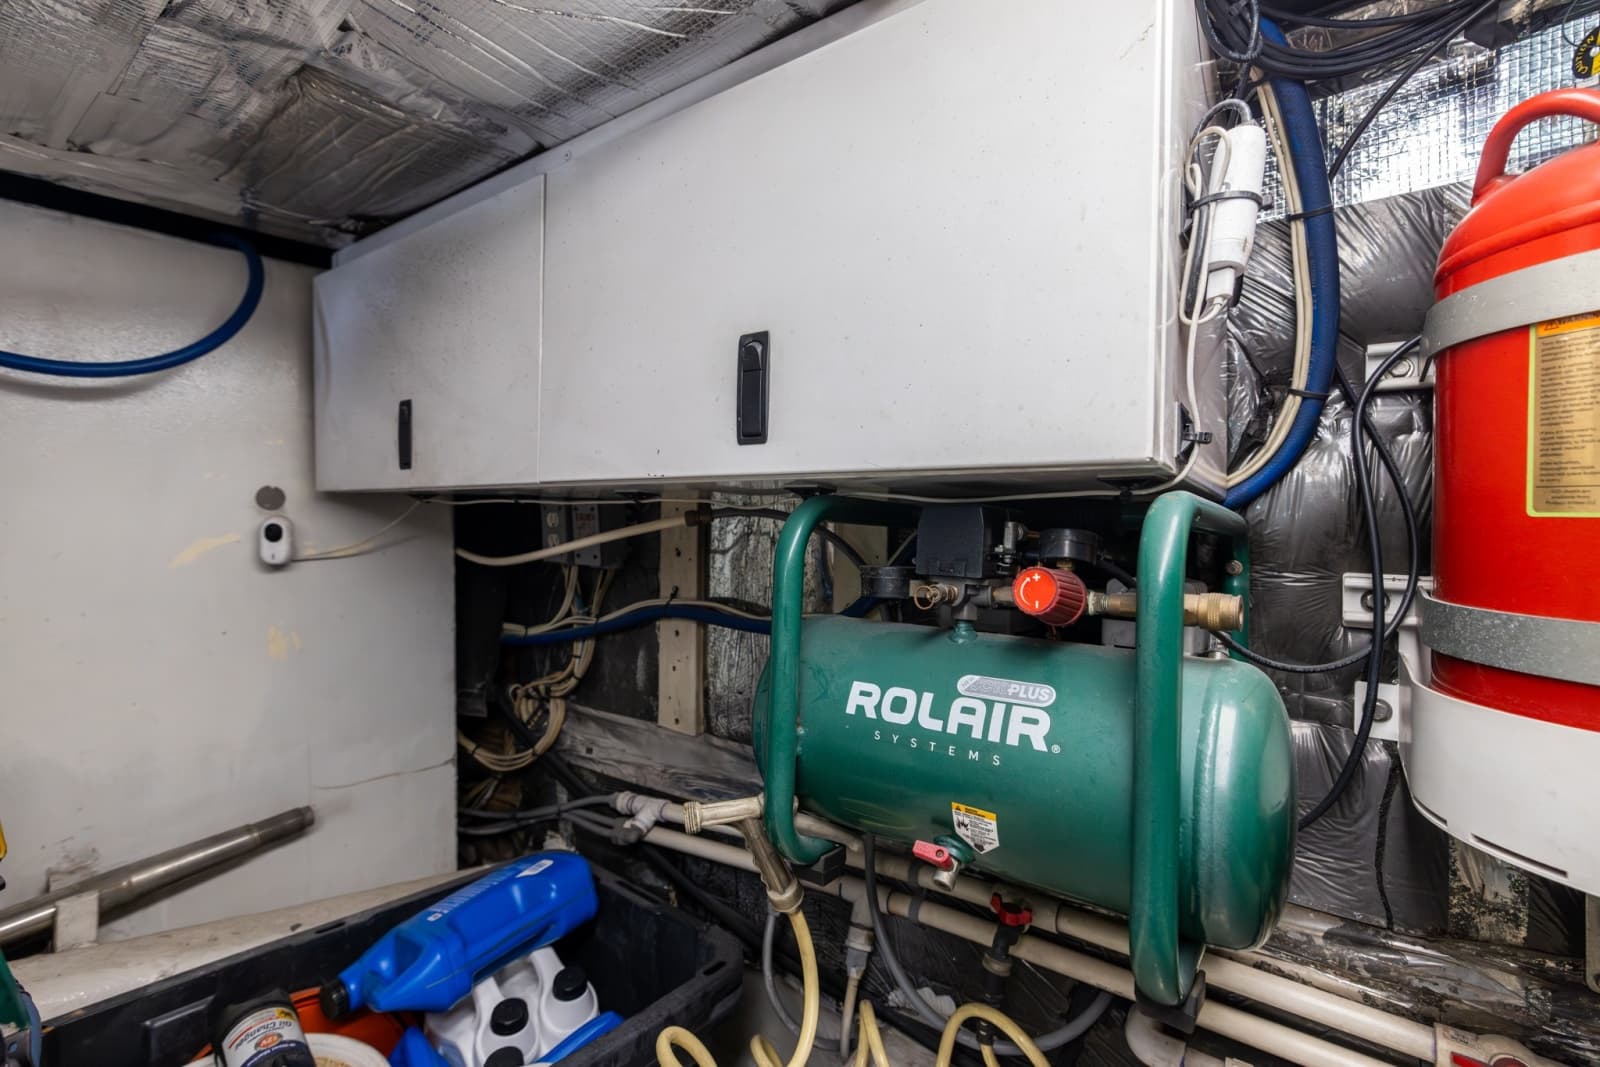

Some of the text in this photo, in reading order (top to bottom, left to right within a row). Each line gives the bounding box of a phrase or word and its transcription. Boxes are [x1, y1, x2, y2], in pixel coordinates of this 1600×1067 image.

[1007, 683, 1051, 701] PLUS
[845, 680, 1050, 752] ROLAIR
[873, 730, 1000, 766] SYSTEMS
